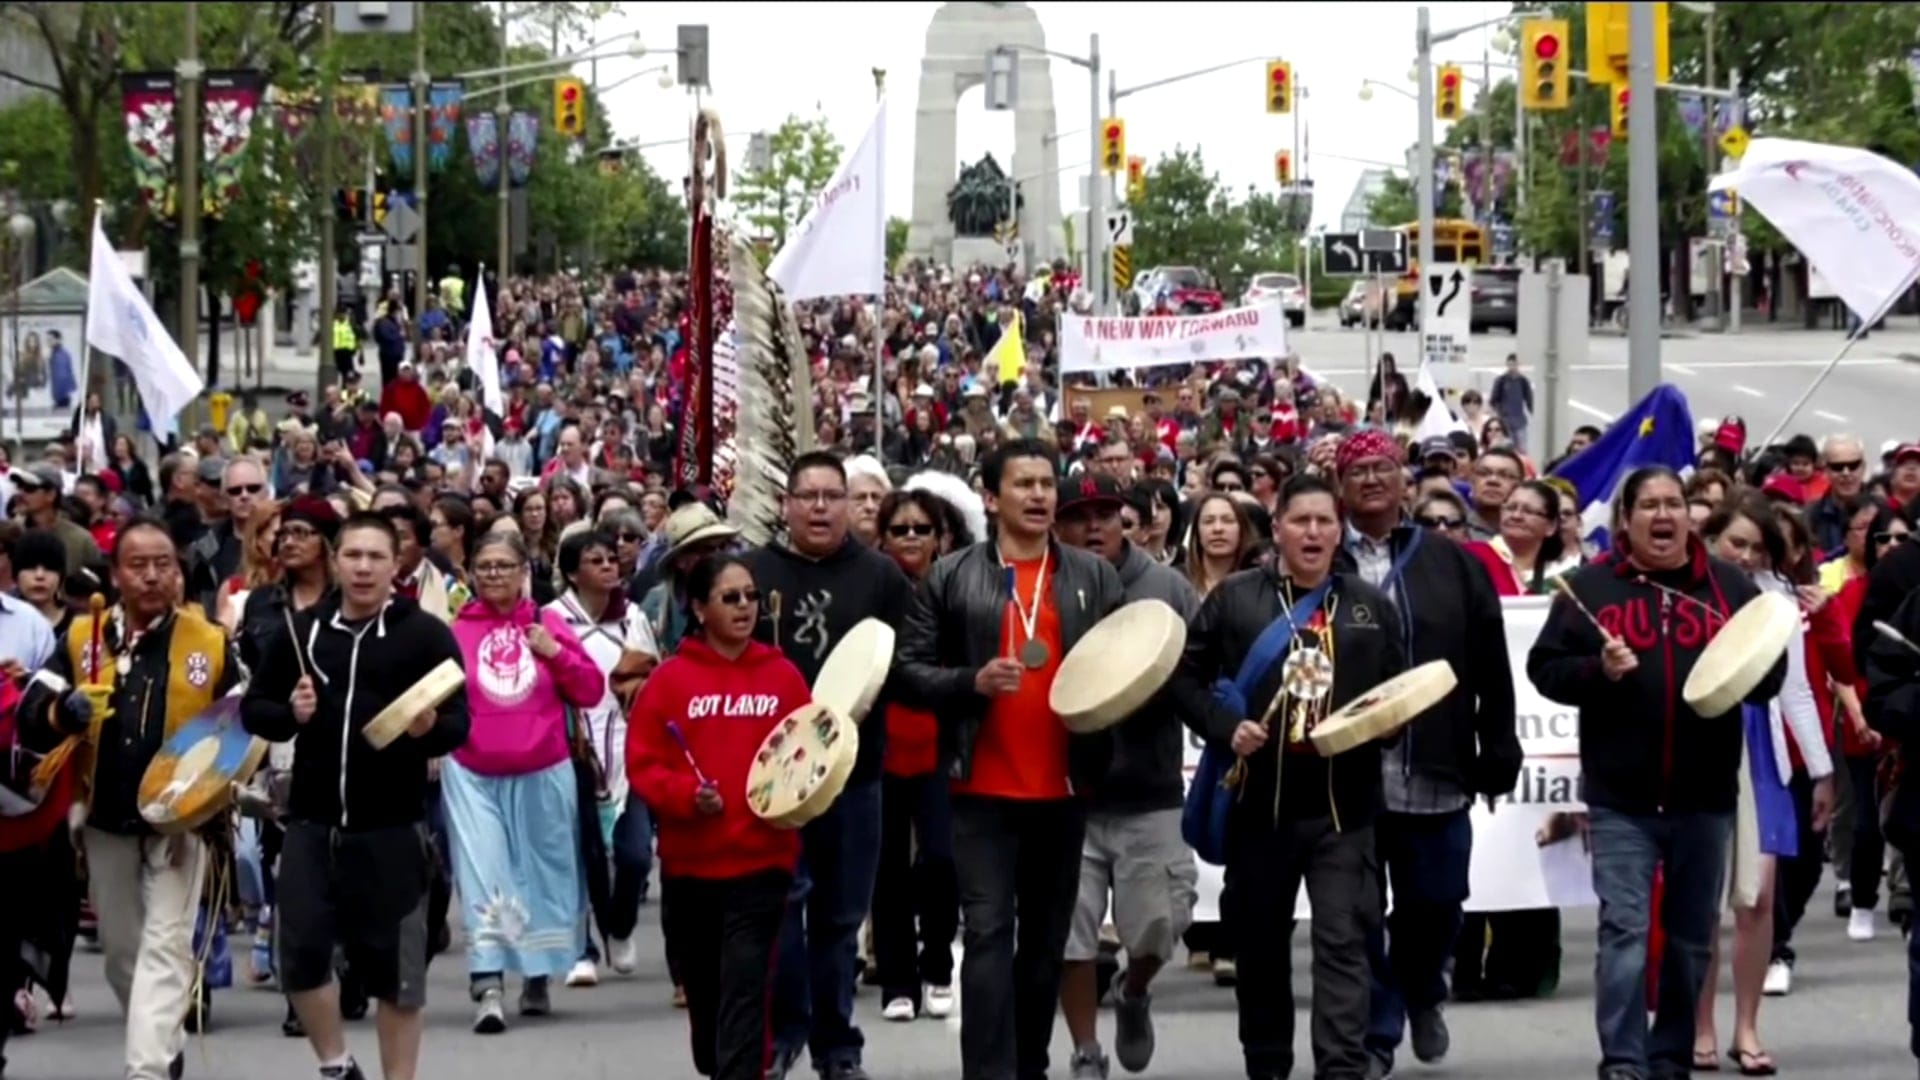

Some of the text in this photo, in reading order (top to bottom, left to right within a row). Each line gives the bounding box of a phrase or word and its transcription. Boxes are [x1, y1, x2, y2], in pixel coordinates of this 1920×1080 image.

[1083, 309, 1260, 340] A NEW WAY FORWARD
[688, 693, 779, 719] GOT LAND?
